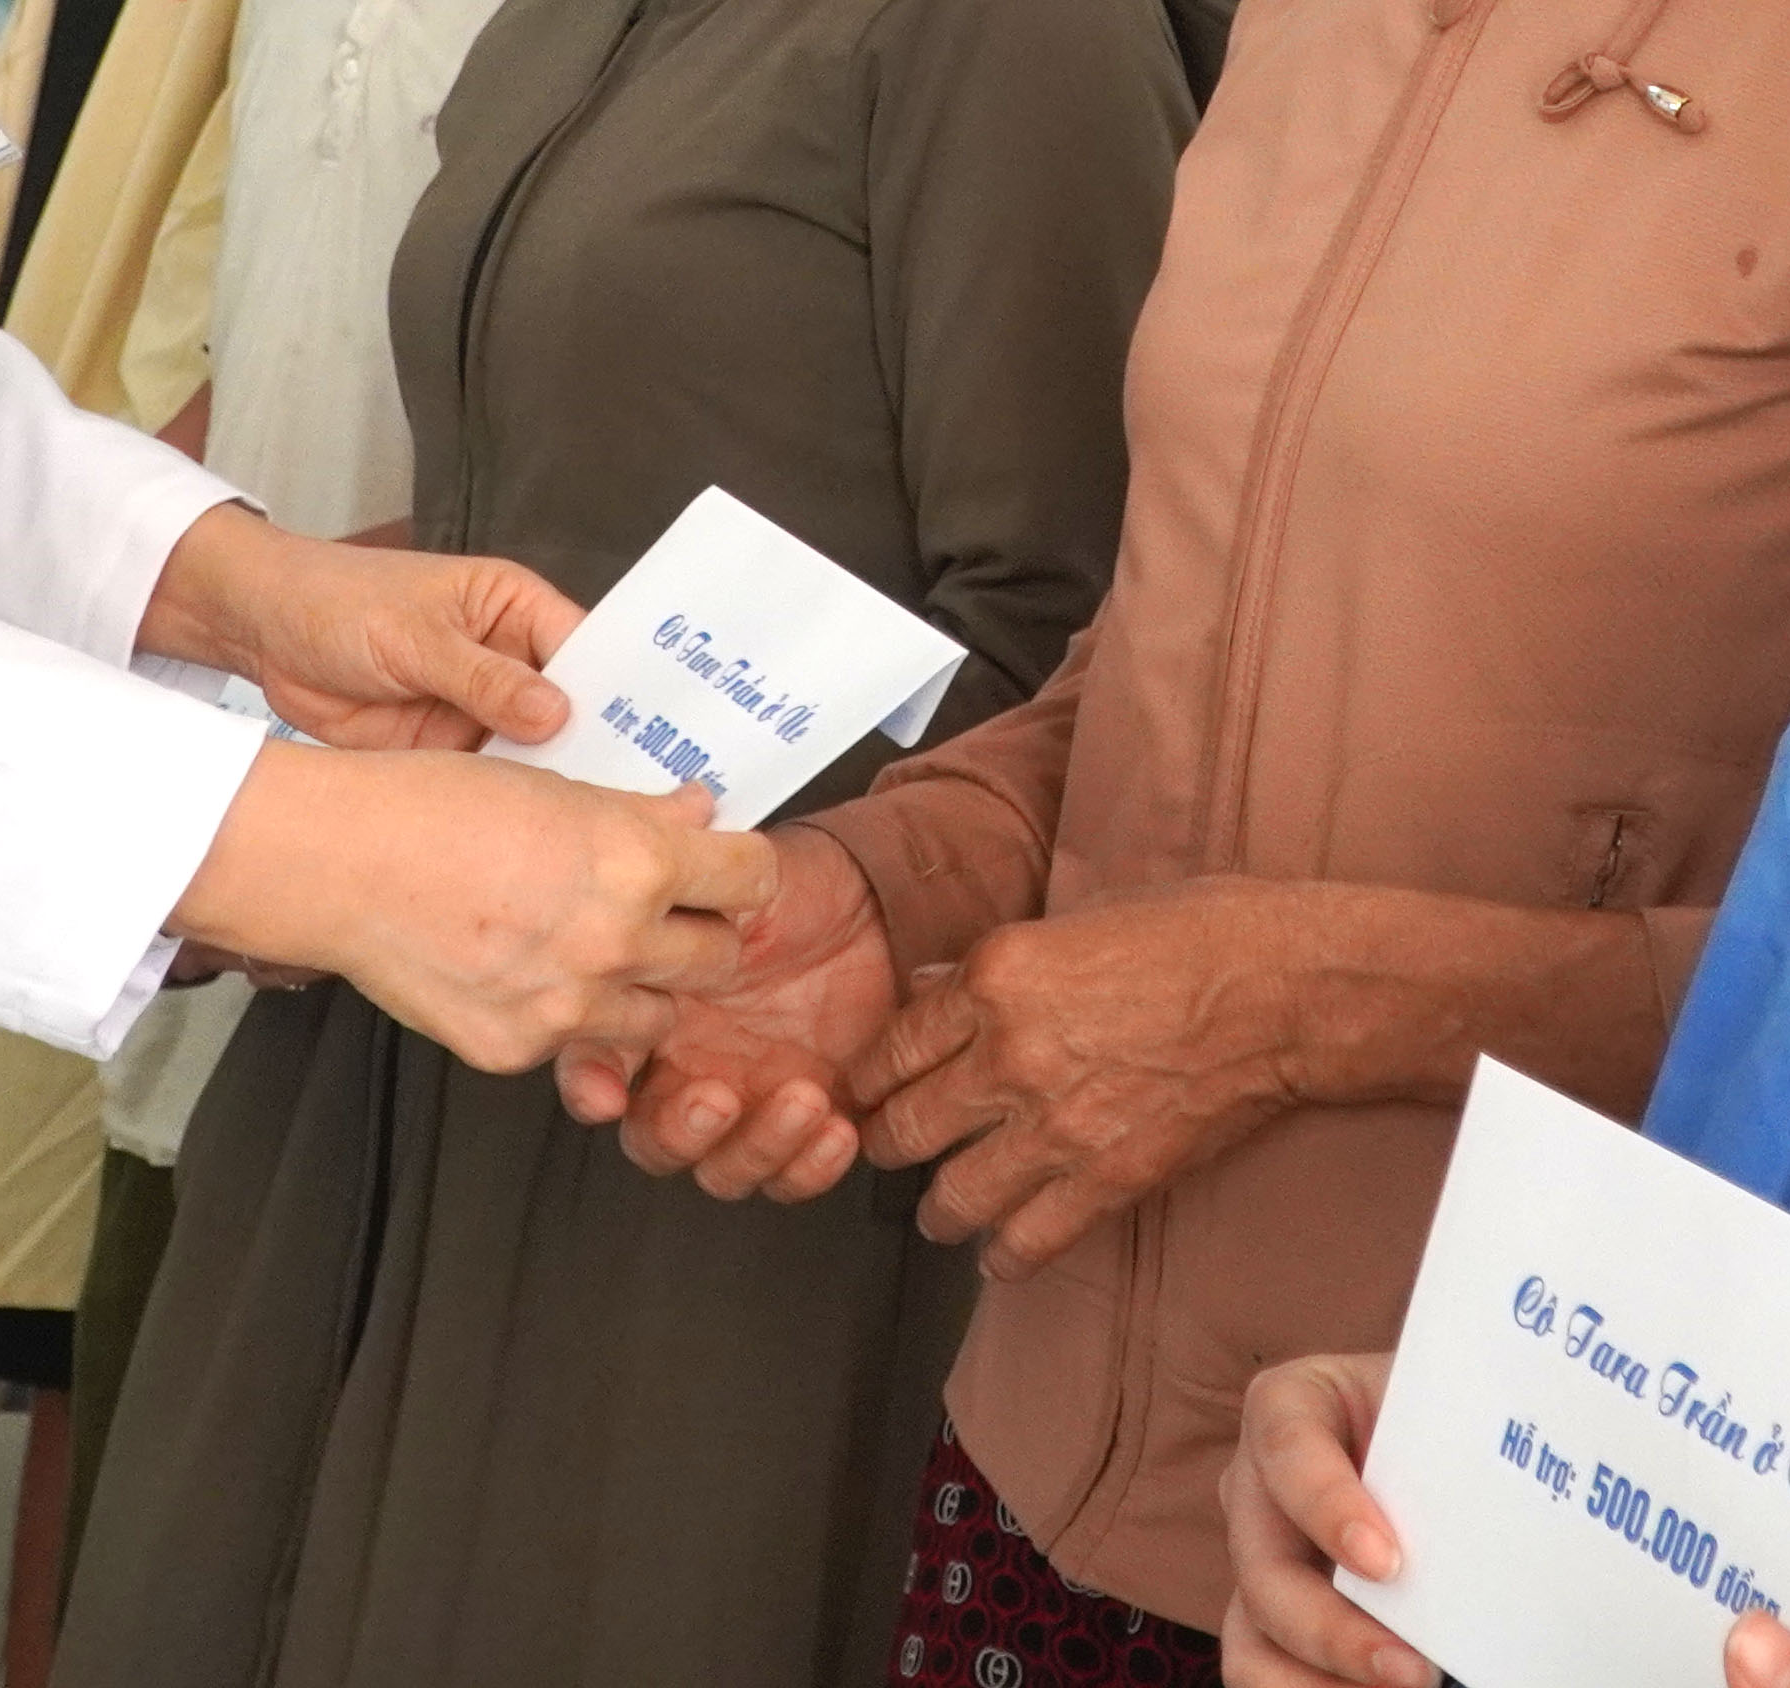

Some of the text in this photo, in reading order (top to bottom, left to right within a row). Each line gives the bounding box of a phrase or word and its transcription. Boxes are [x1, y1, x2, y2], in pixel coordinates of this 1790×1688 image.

[676, 631, 722, 680] Tara
[633, 715, 710, 785] 500.000
[1513, 1275, 1558, 1337] Cô
[1565, 1304, 1649, 1398] Tara
[1658, 1361, 1748, 1460] Trần
[1752, 1423, 1785, 1475] ở
[1500, 1418, 1538, 1470] Hỗ
[1536, 1442, 1577, 1502] trợ:
[1587, 1462, 1718, 1589] 500.000
